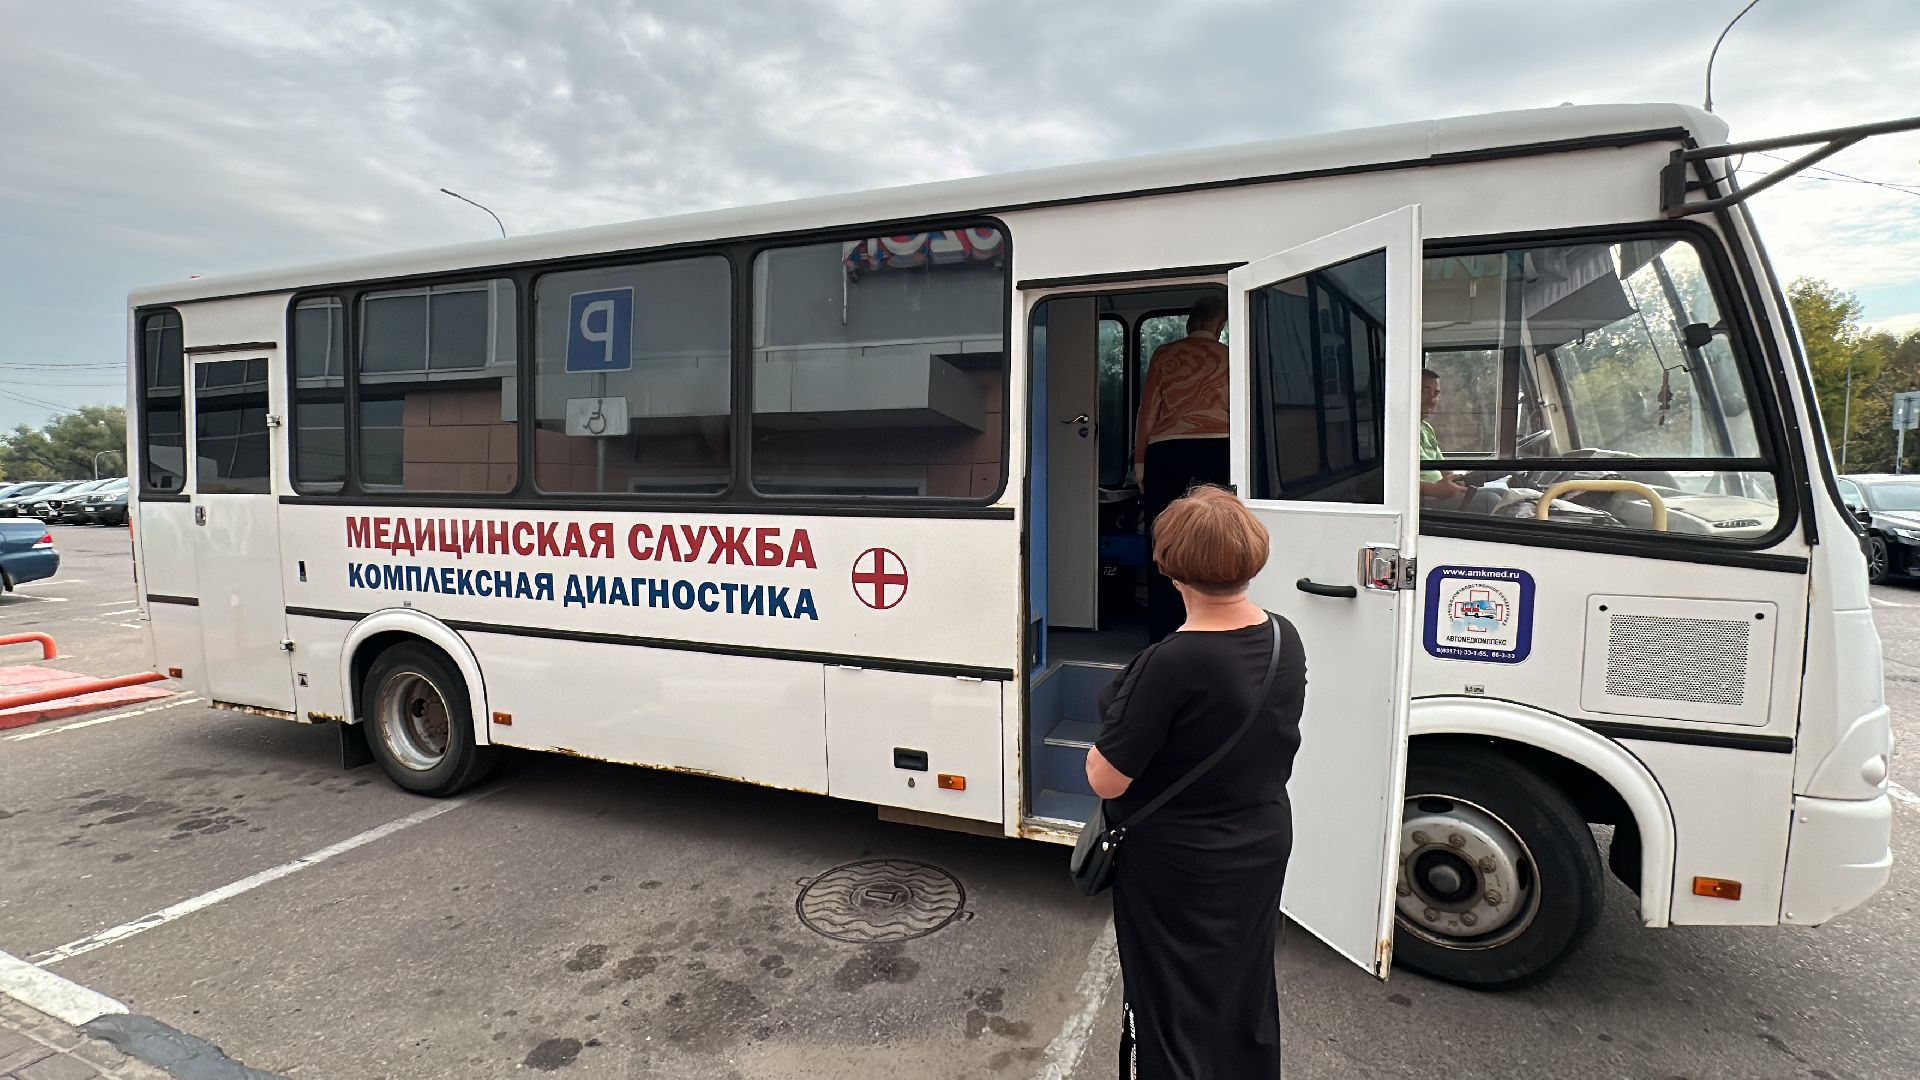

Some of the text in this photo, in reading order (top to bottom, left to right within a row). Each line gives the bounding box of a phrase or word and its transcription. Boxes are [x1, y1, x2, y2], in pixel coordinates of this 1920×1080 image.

[346, 516, 817, 570] МЕДИЦИНСКАЯ СЛУЖБА
[1442, 568, 1520, 579] www.amkmed.ru
[348, 563, 818, 620] КОМПЛЕКСНАЯ ДИАГНОСТИКА
[1446, 635, 1507, 646] АВТОМЕДКОМПЛЕКС
